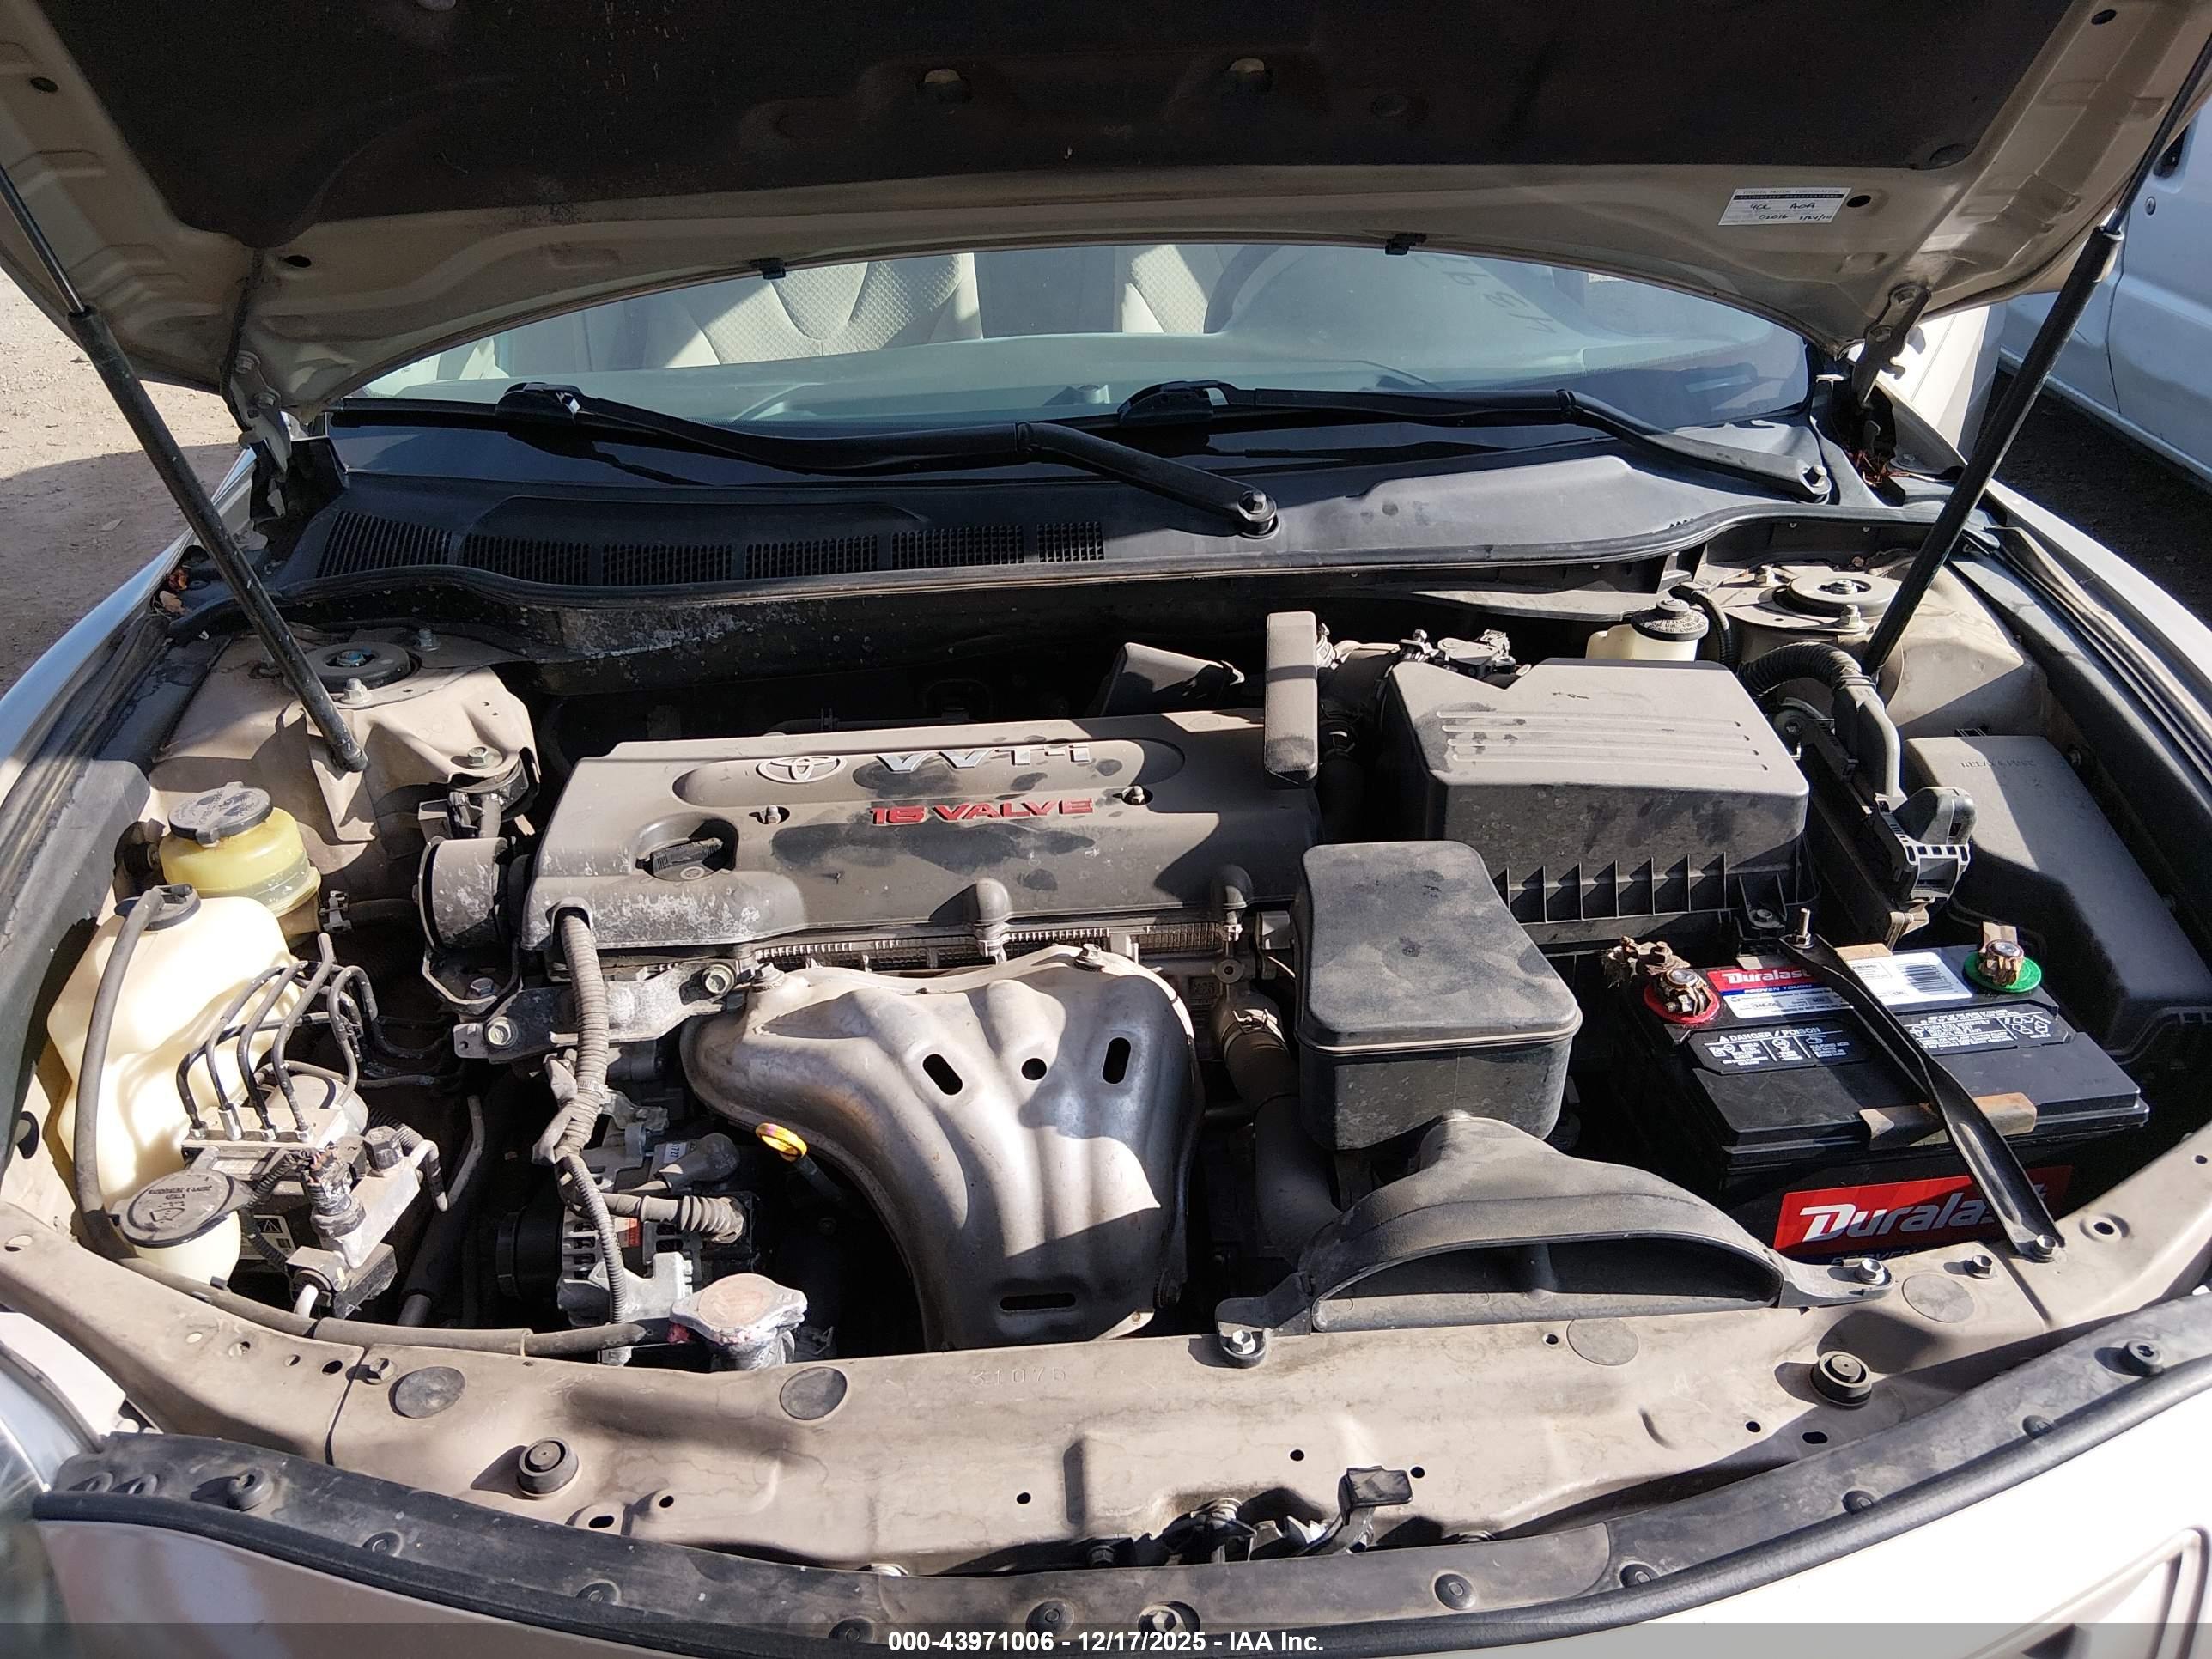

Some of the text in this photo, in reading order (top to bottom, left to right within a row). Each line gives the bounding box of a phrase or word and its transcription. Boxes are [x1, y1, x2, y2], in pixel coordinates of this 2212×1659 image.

[871, 798, 1094, 826] 16 VALVE
[1721, 969, 1812, 985] Duralast
[1729, 1031, 1772, 1042] DANGER
[1782, 1027, 1821, 1036] POISON
